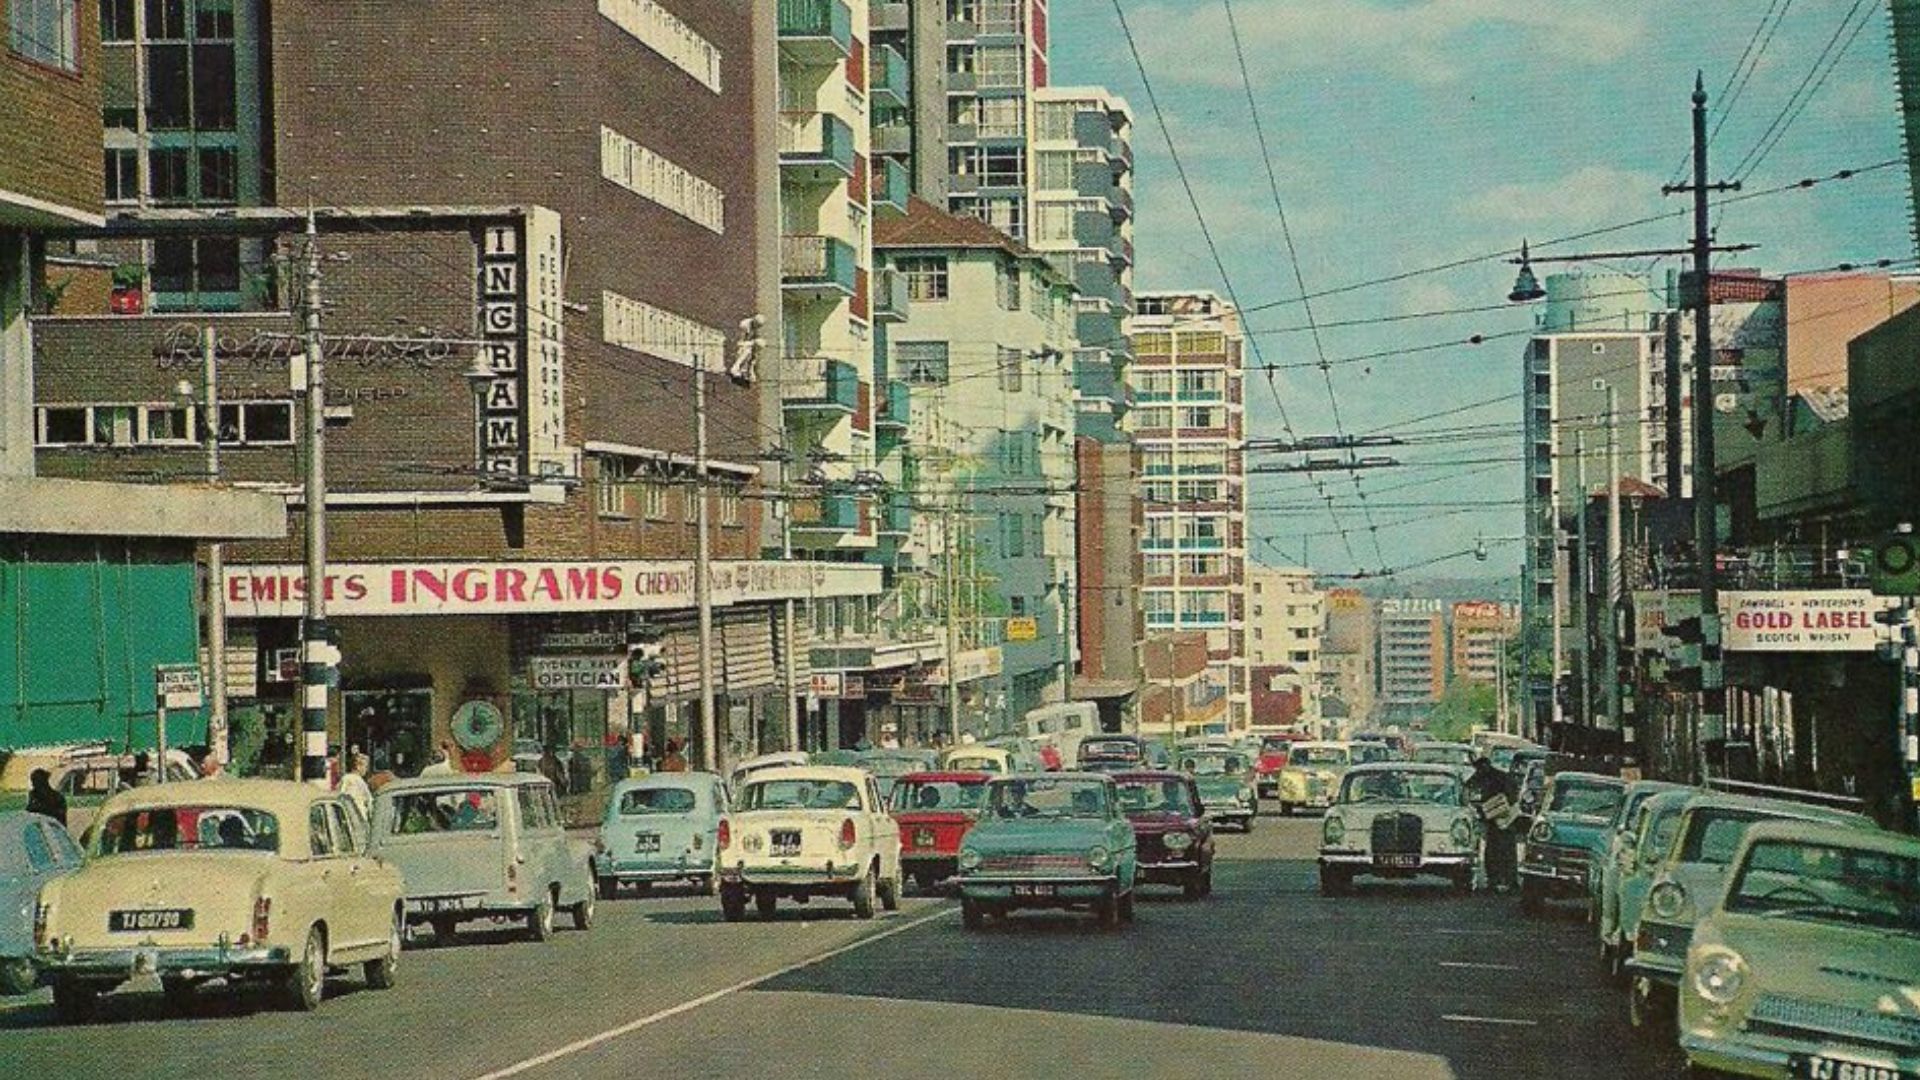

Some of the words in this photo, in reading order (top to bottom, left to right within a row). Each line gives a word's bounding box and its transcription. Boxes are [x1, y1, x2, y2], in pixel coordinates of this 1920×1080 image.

[391, 566, 623, 604] INGRAMS
[1736, 611, 1793, 629] GOLD
[1803, 611, 1872, 629] LABEL
[1757, 633, 1800, 643] SCOTCH
[538, 672, 621, 686] OPTICIAN
[1809, 1056, 1834, 1080] TJ
